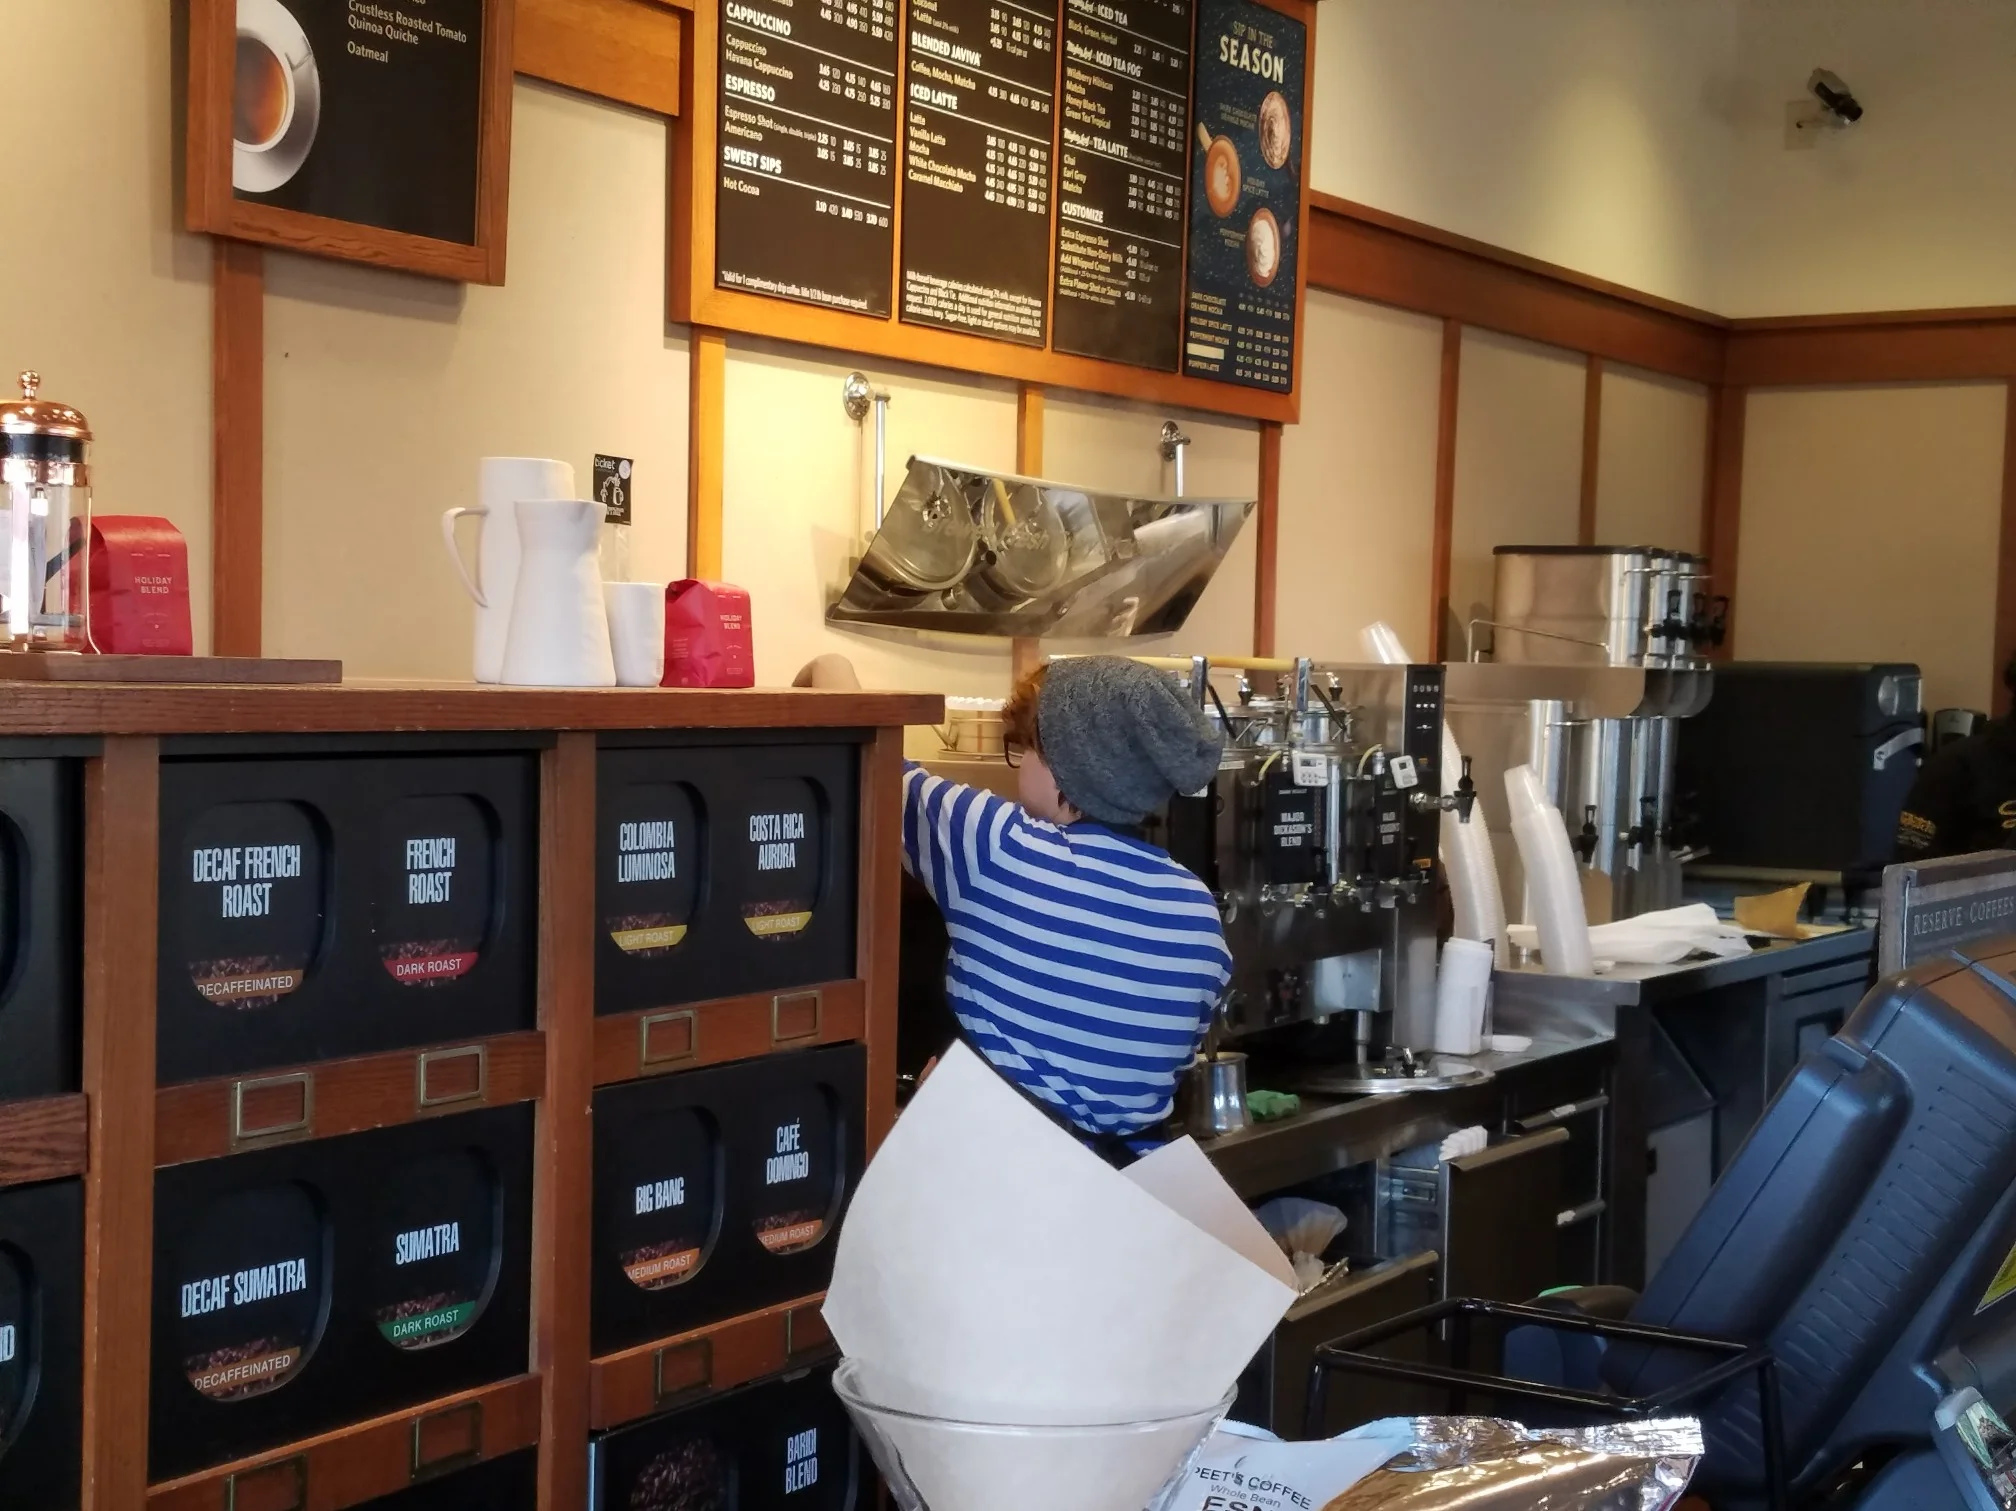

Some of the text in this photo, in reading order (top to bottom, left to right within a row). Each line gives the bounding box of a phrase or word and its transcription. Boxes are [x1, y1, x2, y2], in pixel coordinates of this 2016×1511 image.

[348, 0, 467, 43] Crustless Roasted Tomato
[726, 2, 791, 36] CAPPUCCINO
[1098, 3, 1114, 20] ICED
[1115, 10, 1128, 26] TEA
[348, 14, 419, 45] Quinoa Quiche
[1247, 26, 1257, 41] IN
[1258, 31, 1274, 49] THE
[347, 41, 389, 63] Oatmeal
[725, 33, 767, 56] Cappuccino
[911, 31, 951, 56] BLENDED
[725, 49, 794, 80] Havana Cappuccino
[1096, 50, 1112, 67] ICED
[1113, 56, 1126, 72] TEA
[1127, 62, 1142, 77] FOG
[1220, 35, 1284, 84] SEASON
[725, 73, 776, 102] ESPRESSO
[910, 82, 931, 101] ICED
[931, 89, 958, 110] LATTE
[724, 105, 774, 130] Espresso Shot
[910, 111, 926, 126] Latte
[724, 121, 763, 142] Americano
[909, 125, 947, 146] Vanilla Latte
[723, 146, 782, 174] SWEET SIPS
[909, 140, 930, 156] Mocha
[1093, 136, 1107, 152] TEA
[1107, 141, 1129, 158] LATTE
[908, 154, 977, 183] White Chocolate Mocha
[908, 168, 933, 185] Caramel
[723, 176, 760, 196] Hot Cocoa
[1061, 201, 1104, 224] CUSTOMIZE
[134, 576, 172, 584] HOLIDAY
[140, 586, 169, 594] BLEND
[720, 614, 742, 622] HOLIDAY
[750, 812, 805, 842] COSTA RICA
[1274, 824, 1313, 835] DICKASON'S
[1281, 812, 1305, 823] MAJOR
[620, 820, 675, 852] COLOMBIA
[1281, 836, 1302, 847] BLEND
[193, 844, 301, 883] DECAF FRENCH
[406, 837, 456, 870] FRENCH
[618, 851, 676, 883] LUMINOSA
[758, 843, 796, 871] AURORA
[222, 883, 272, 918] ROAST
[409, 871, 452, 904] ROAST
[776, 917, 801, 929] ROAST
[1913, 906, 1963, 936] RESERVE
[619, 930, 674, 946] LIGHT ROAST
[396, 958, 462, 977] DARK ROAST
[197, 975, 293, 997] DECAFFEINATED
[776, 1117, 800, 1154] CAFÉ
[766, 1151, 809, 1185] DOMINGO
[635, 1176, 685, 1215] BIG BANG
[395, 1221, 460, 1266] SUMATRA
[789, 1224, 815, 1240] ROAST
[627, 1254, 692, 1281] MEDIUM ROAST
[181, 1258, 307, 1318] DECAF SUMATRA
[393, 1309, 460, 1338] DARK ROAST
[194, 1354, 291, 1391] DECAFFEINATED
[787, 1427, 817, 1465] BARIDI
[785, 1456, 818, 1495] BLEND
[1210, 1484, 1247, 1501] Whole
[1250, 1493, 1282, 1509] Bean
[1248, 1475, 1313, 1510] COFFEE
